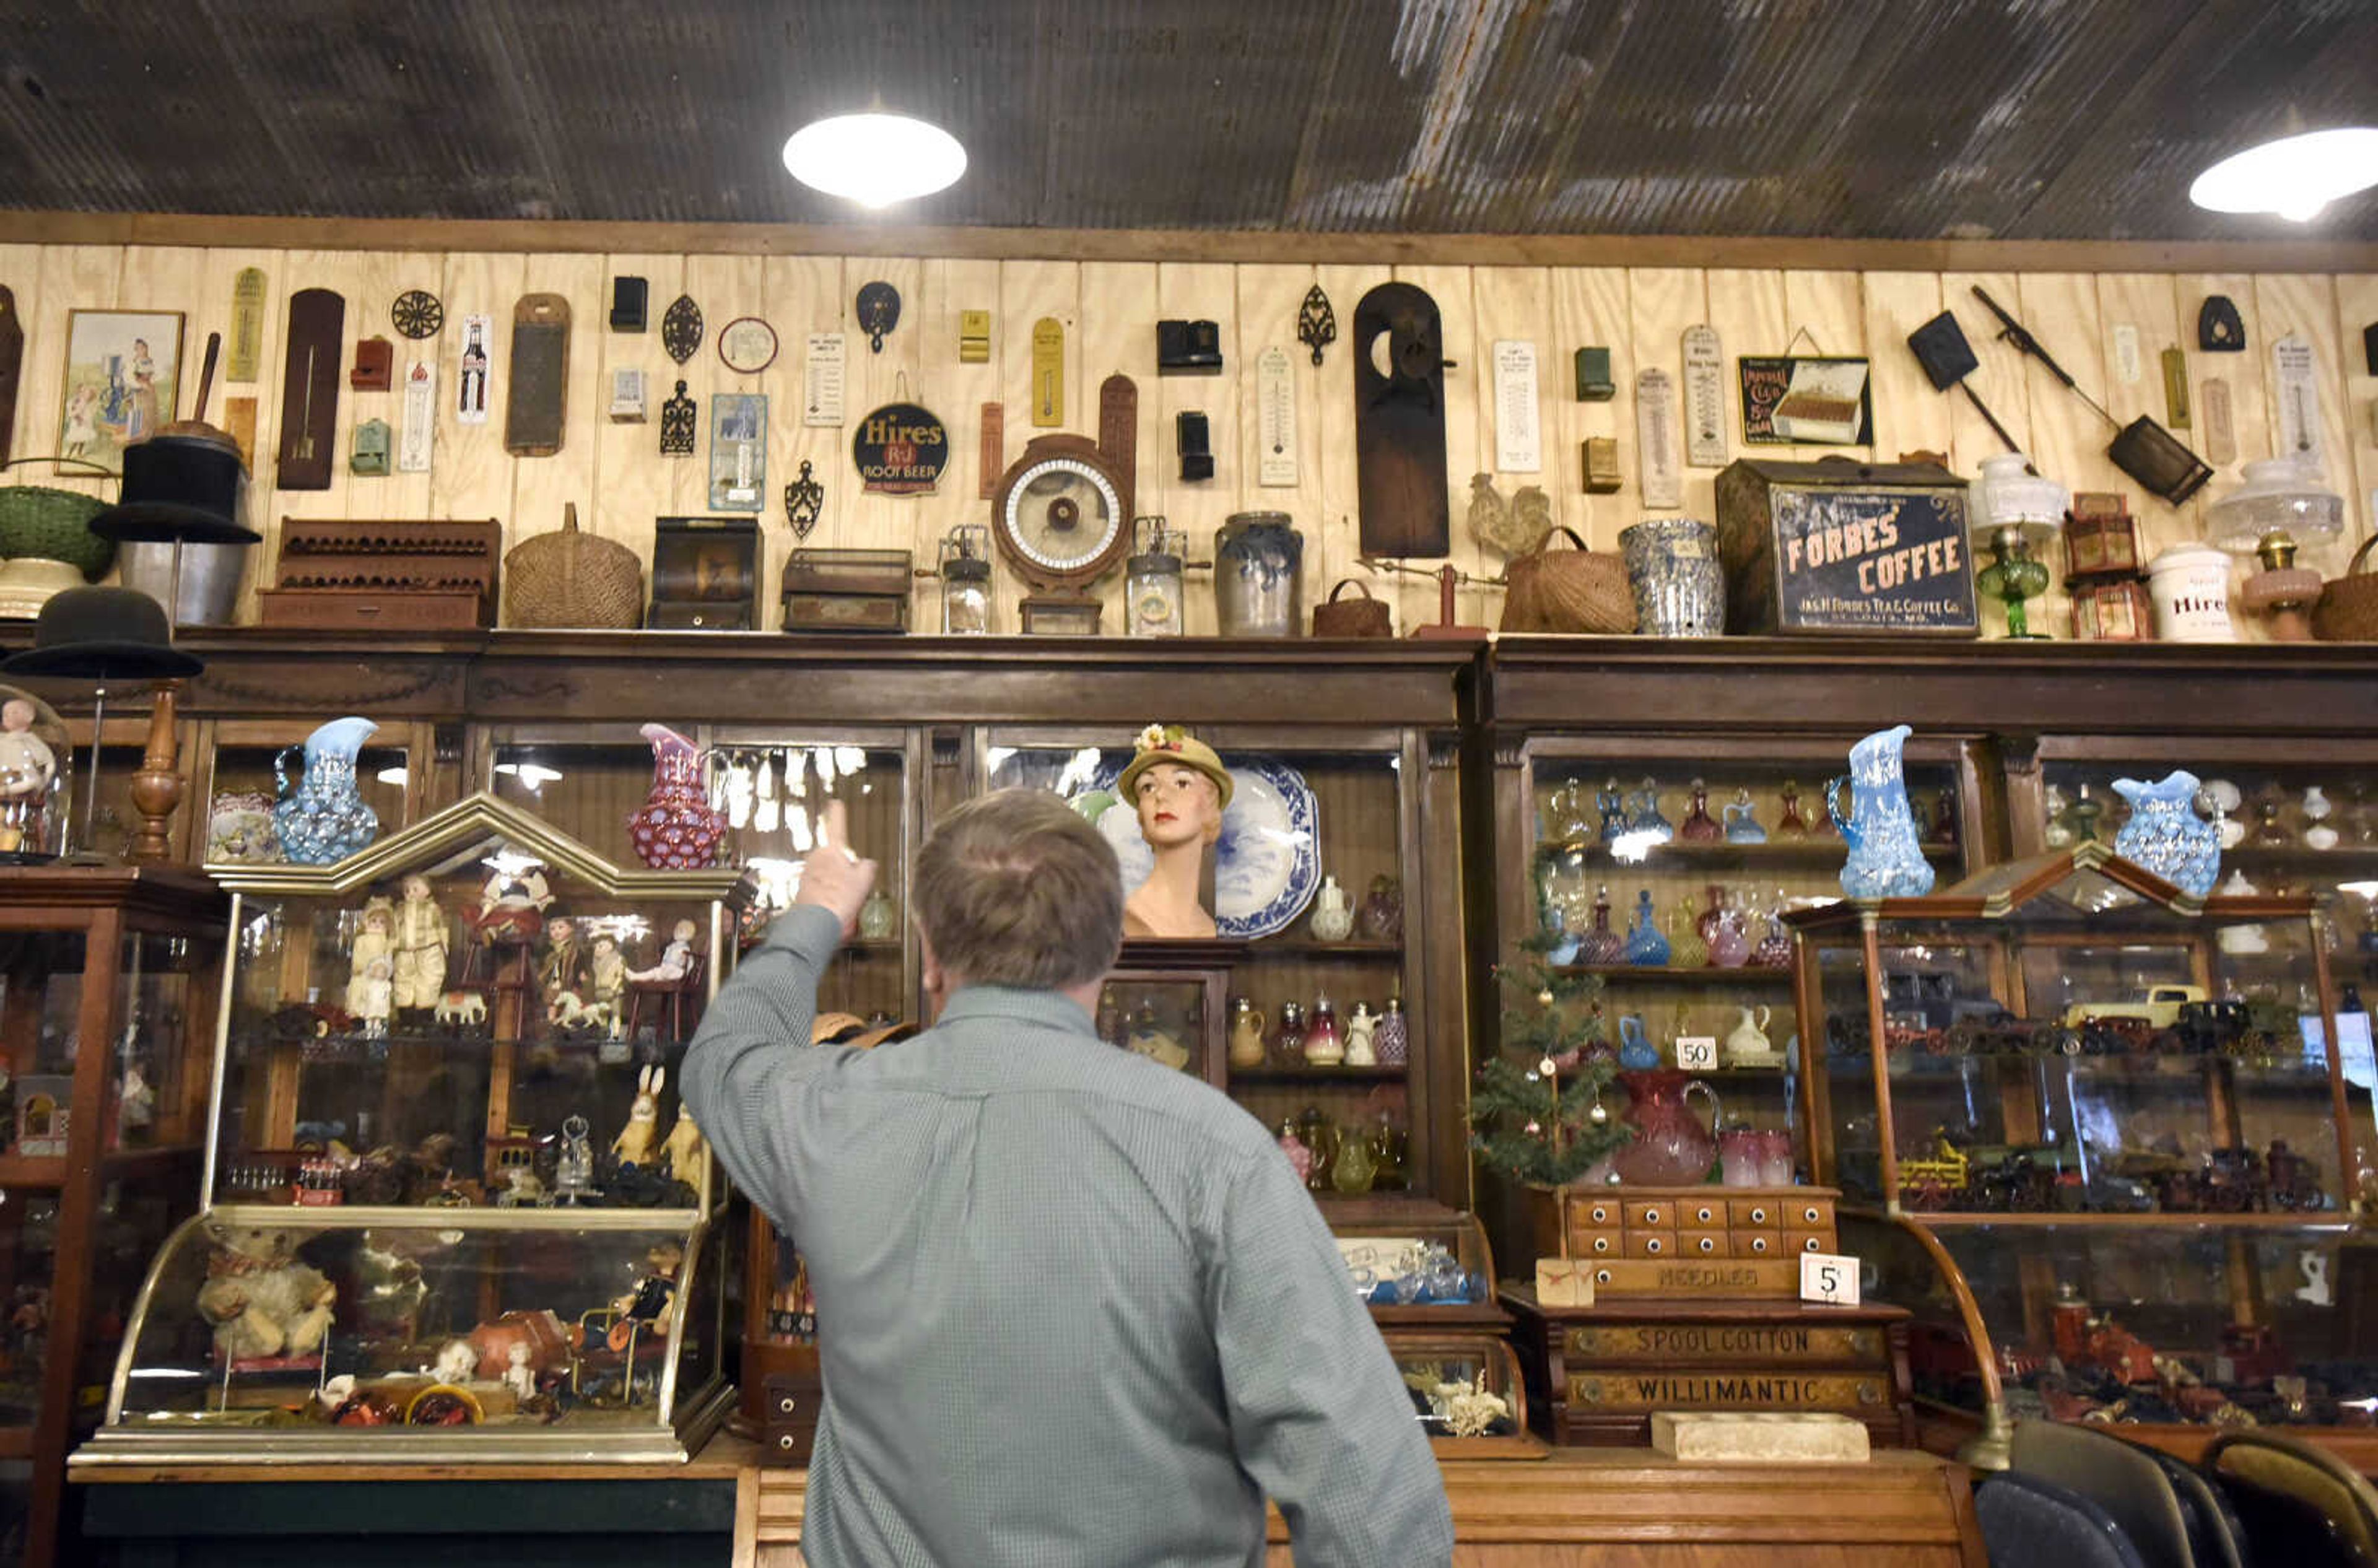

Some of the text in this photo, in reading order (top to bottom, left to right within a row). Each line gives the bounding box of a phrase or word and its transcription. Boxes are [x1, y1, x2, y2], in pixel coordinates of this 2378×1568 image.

[865, 414, 942, 445] Hires
[863, 465, 936, 478] ROOT BEER
[1858, 535, 1961, 595] COFFEE
[1638, 1330, 1809, 1353] SPOOL COTTON
[1638, 1379, 1820, 1403] WILLIMANTIC
